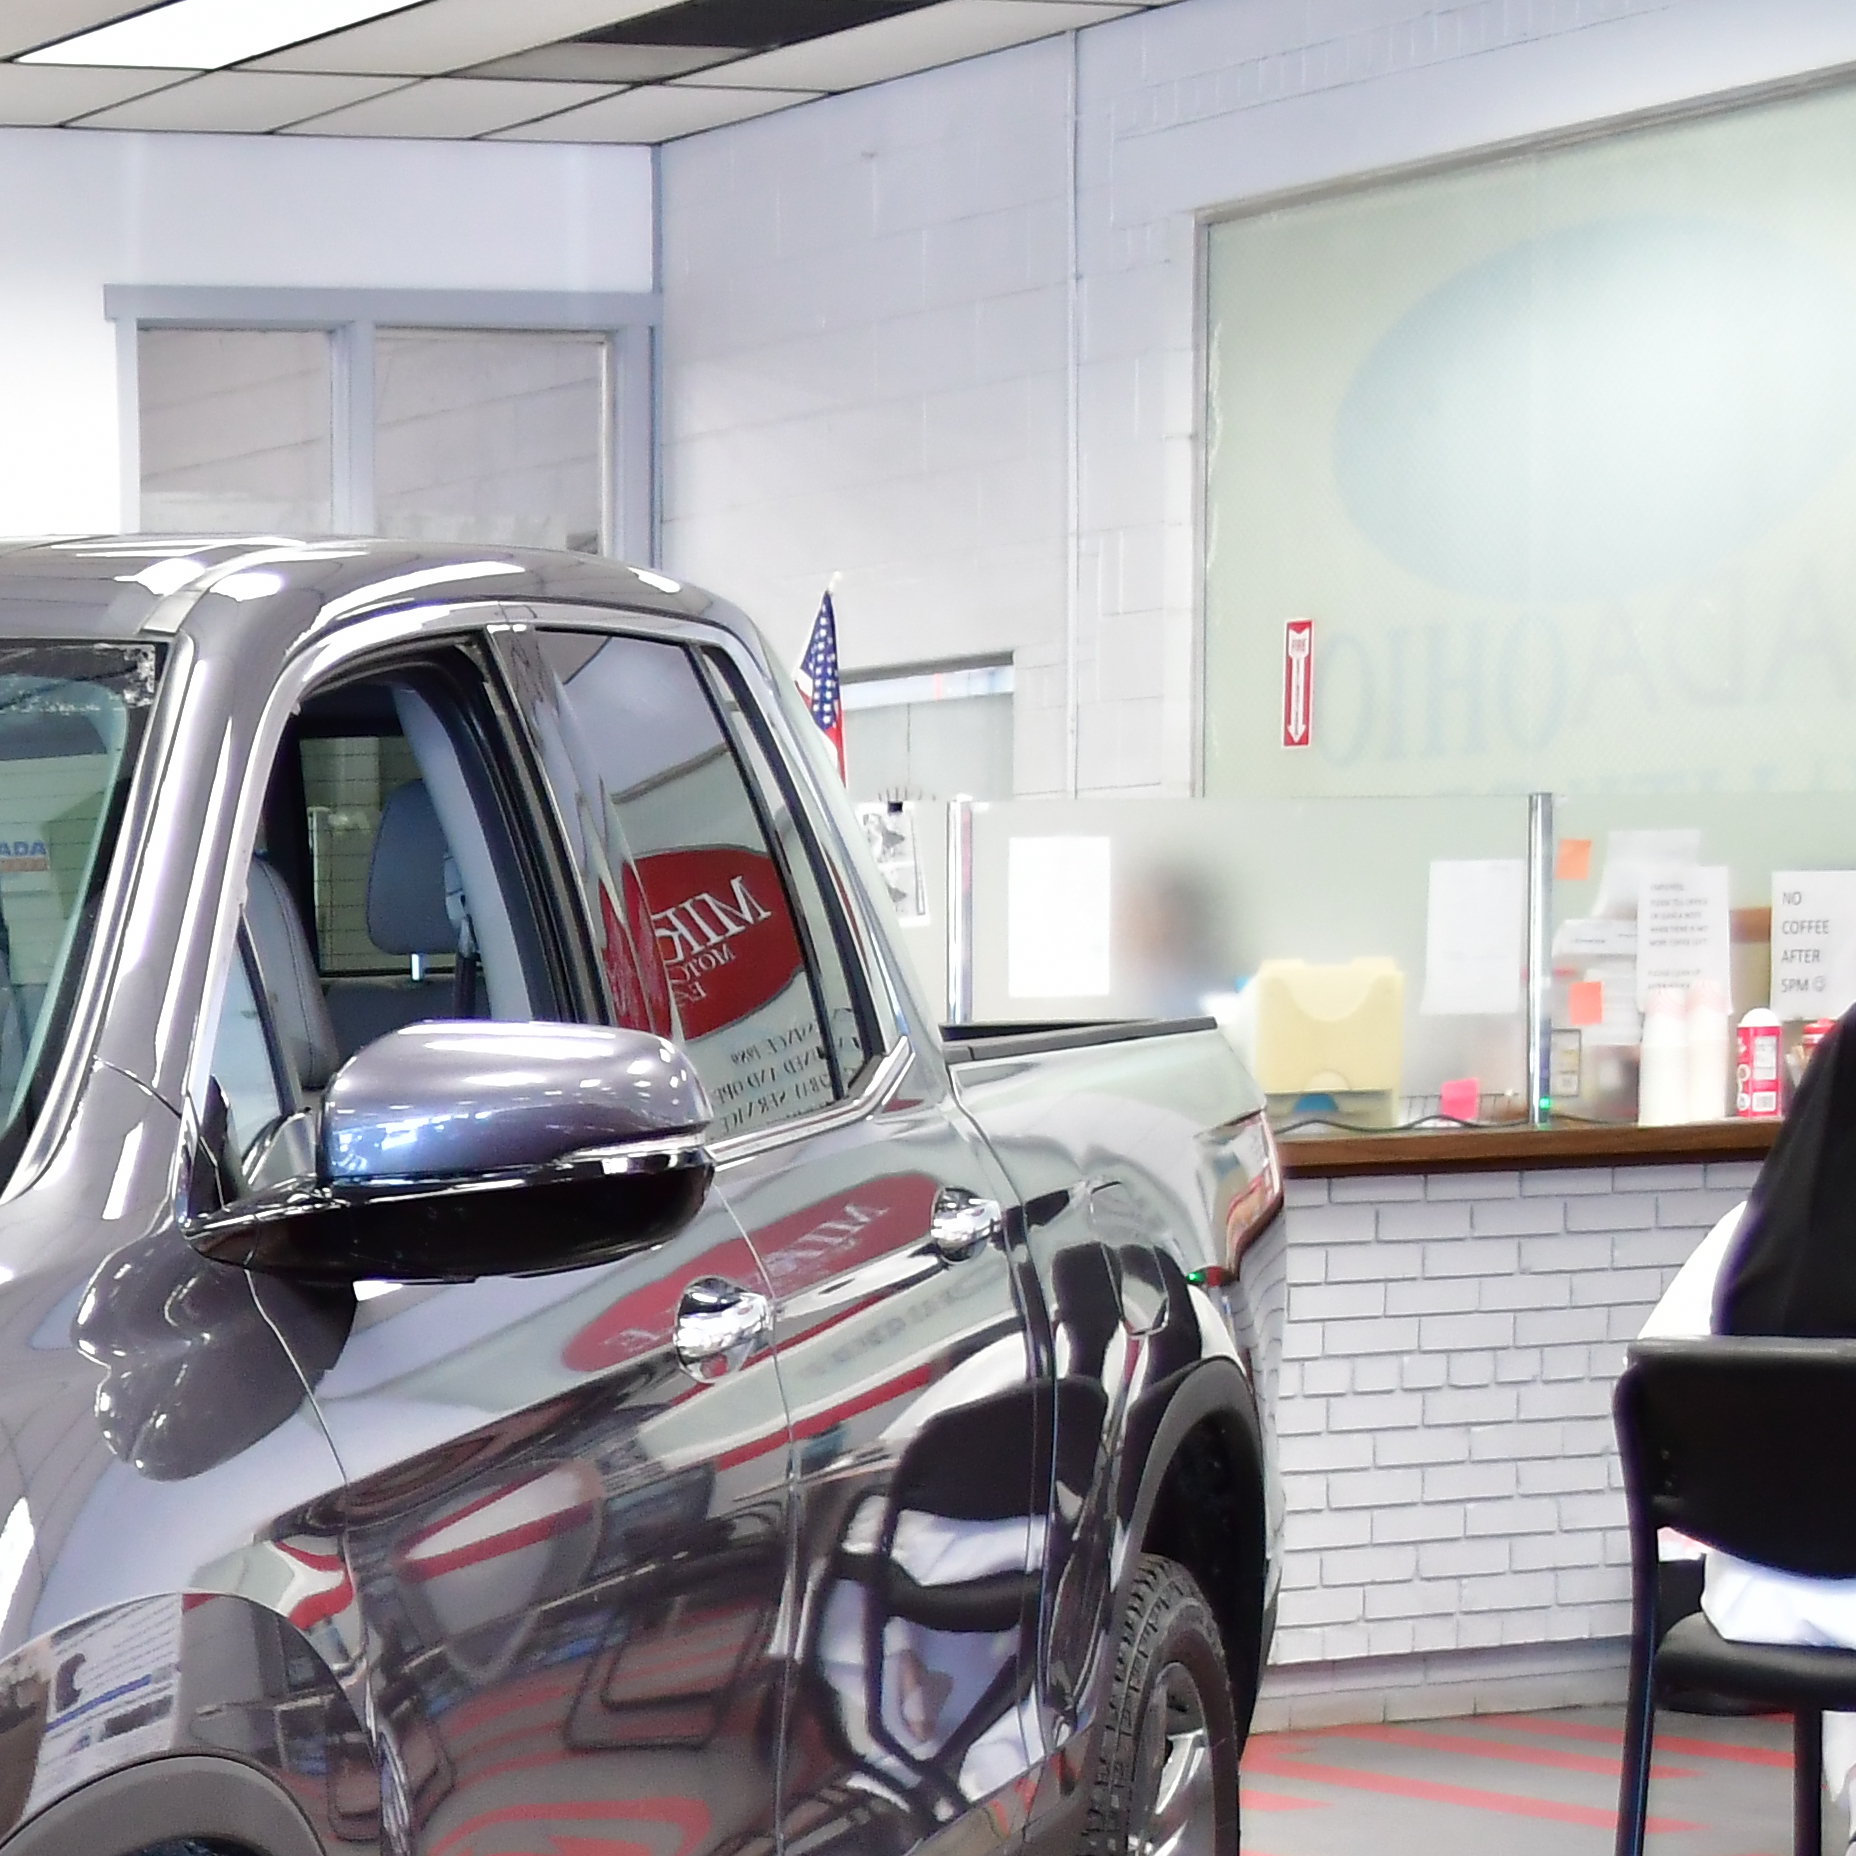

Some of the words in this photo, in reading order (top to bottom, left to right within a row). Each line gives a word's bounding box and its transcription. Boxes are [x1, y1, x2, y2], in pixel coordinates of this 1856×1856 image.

[1782, 891, 1802, 906] NO
[1782, 920, 1830, 935] COFFEE
[1781, 949, 1821, 964] AFTER
